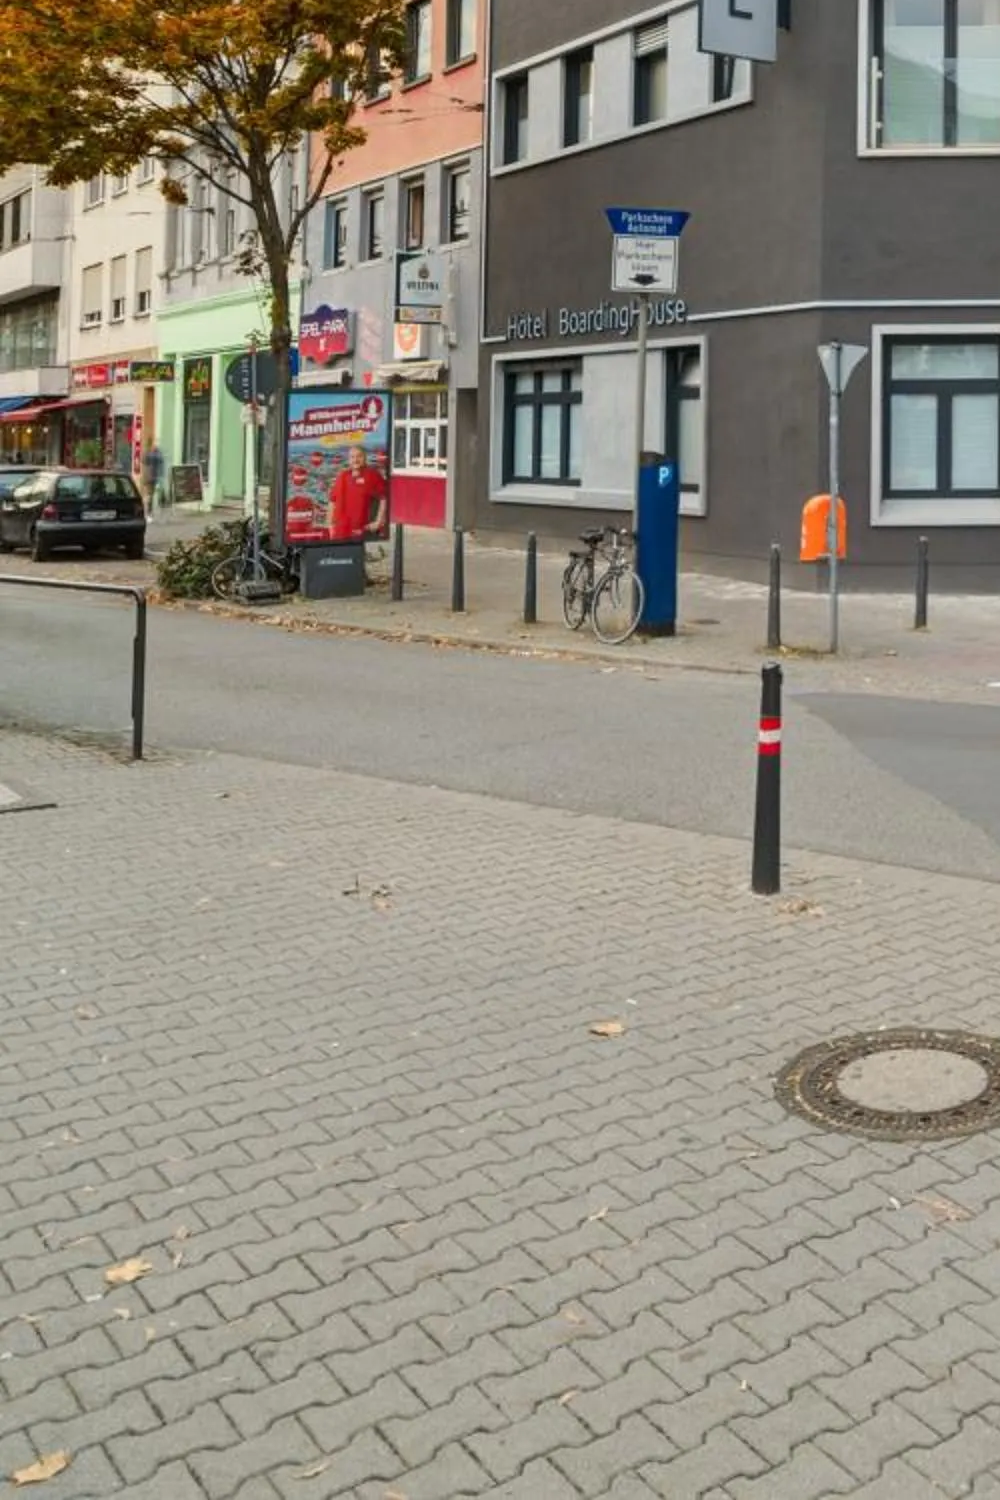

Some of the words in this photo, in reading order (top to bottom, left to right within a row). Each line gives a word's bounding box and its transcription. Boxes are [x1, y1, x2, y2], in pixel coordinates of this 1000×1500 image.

[507, 308, 547, 340] Hotel
[290, 415, 371, 437] Mannheim
[658, 466, 670, 485] P
